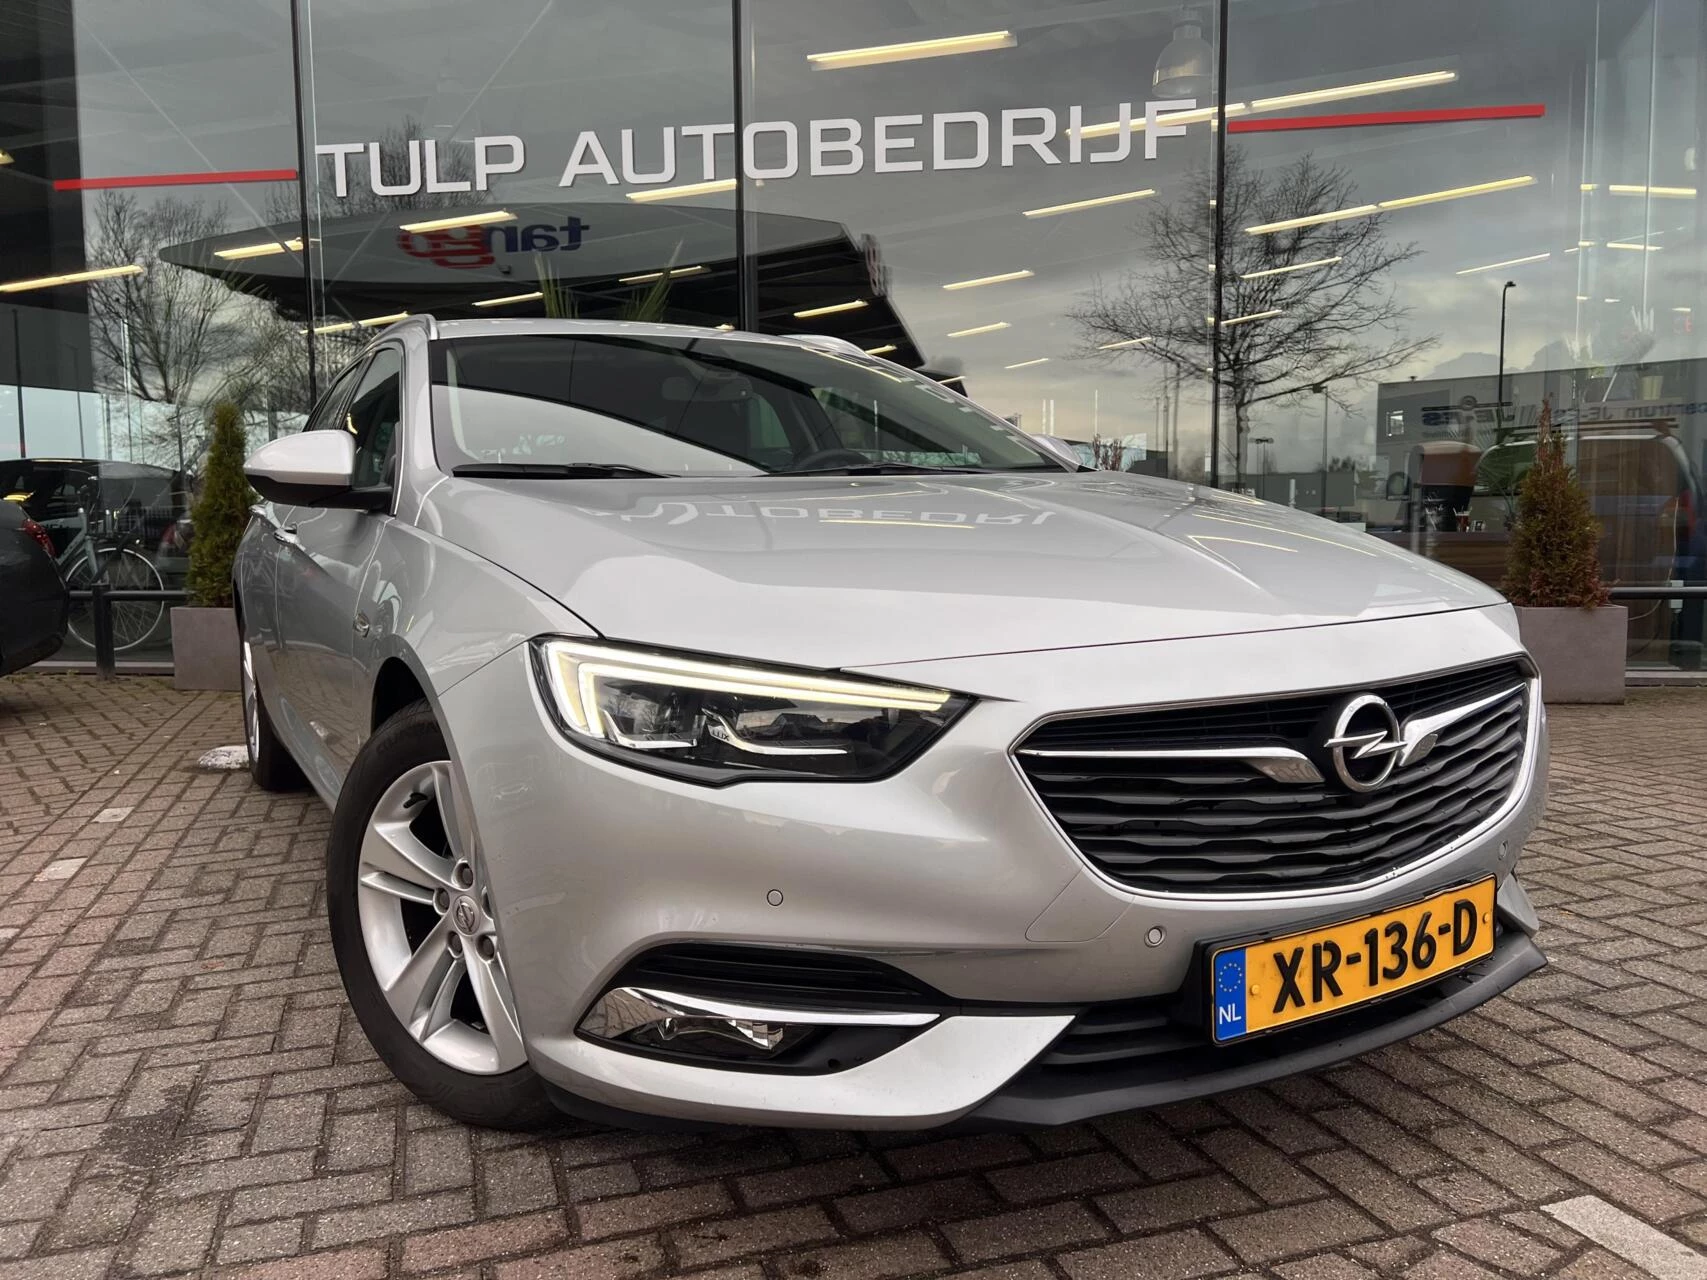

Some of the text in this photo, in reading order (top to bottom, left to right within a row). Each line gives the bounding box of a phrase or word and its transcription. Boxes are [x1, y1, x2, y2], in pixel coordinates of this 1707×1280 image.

[316, 99, 1197, 197] TULP AUTOBEDRIJF
[1272, 900, 1478, 1014] XR-136-D
[1218, 1003, 1242, 1025] NL
